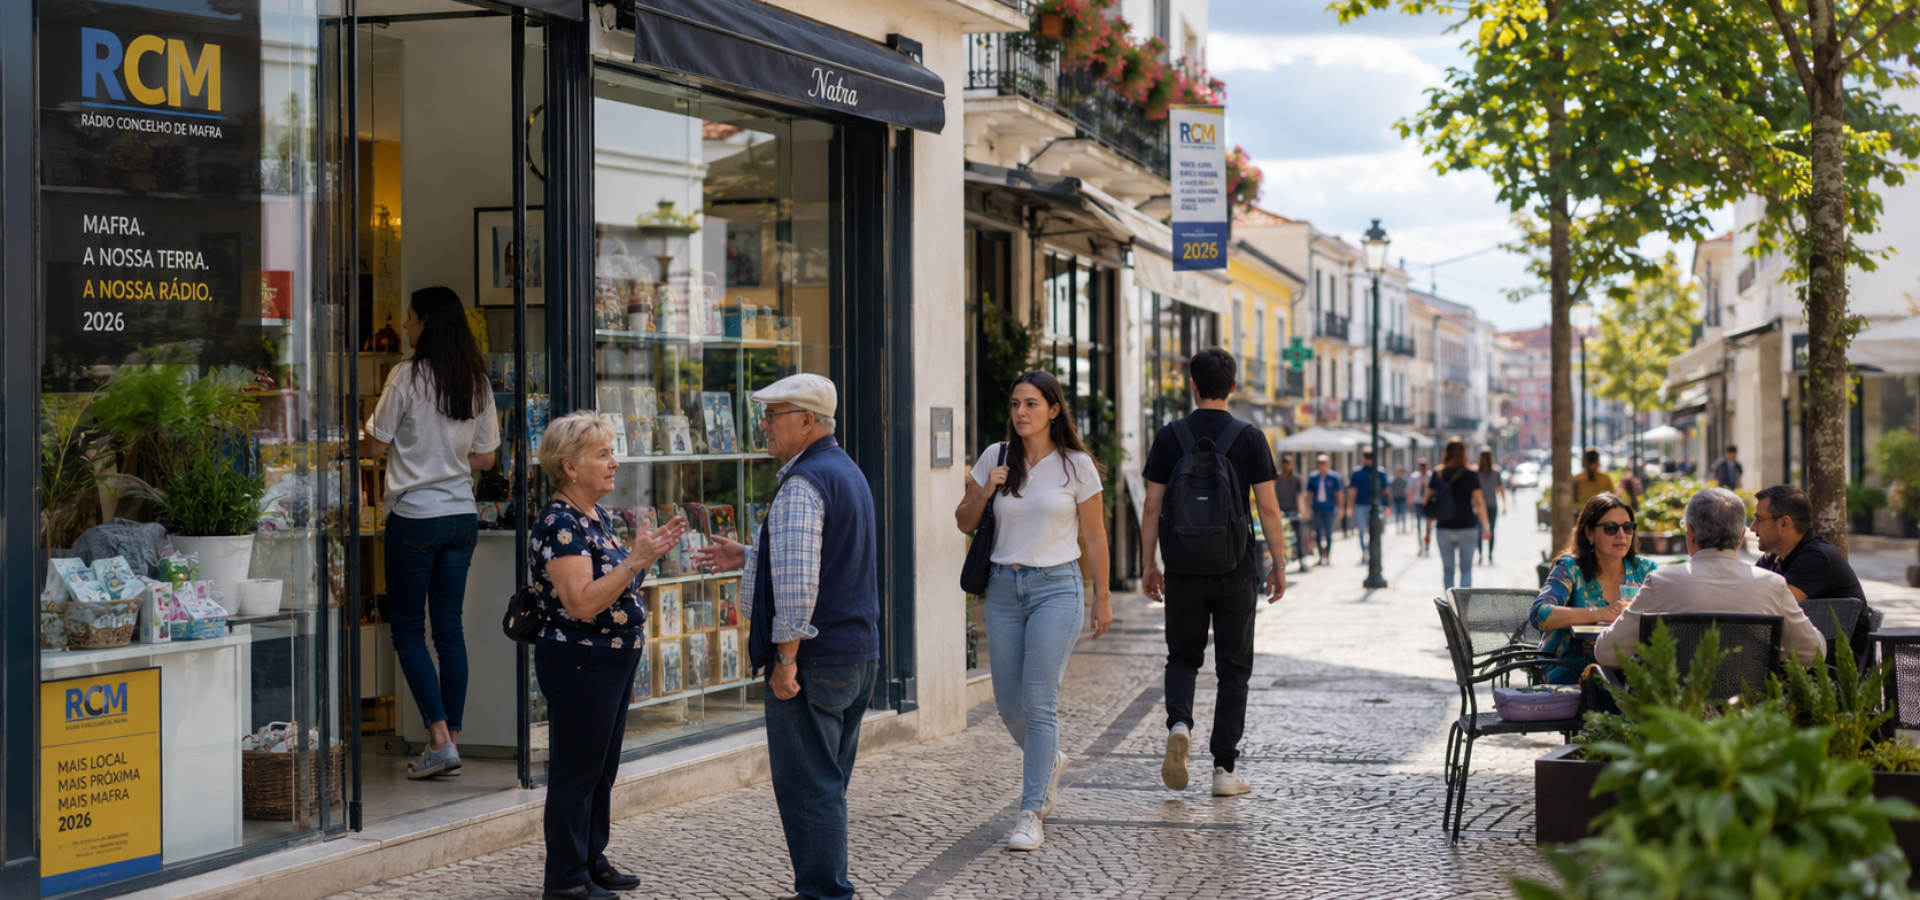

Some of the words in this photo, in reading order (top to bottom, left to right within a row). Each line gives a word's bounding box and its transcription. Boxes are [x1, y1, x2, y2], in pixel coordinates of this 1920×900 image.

[81, 27, 221, 111] RCM
[808, 67, 858, 106] Natra
[81, 112, 115, 129] RÁDIO
[117, 117, 172, 134] CONCELHO
[174, 122, 187, 135] DE
[189, 124, 222, 138] MAFRA
[1180, 122, 1215, 144] RCM
[83, 214, 145, 236] MAFRA.
[83, 247, 95, 266] A
[100, 248, 154, 268] NOSSA
[158, 250, 209, 270] TERRA.
[1183, 242, 1218, 260] 2026
[83, 281, 95, 299] A
[100, 281, 154, 300] NOSSA
[160, 276, 213, 301] RÁDIO.
[83, 311, 125, 332] 2026
[65, 682, 128, 720] RCM
[58, 757, 87, 774] MAIS
[90, 752, 128, 770] LOCAL
[58, 775, 87, 792] MAIS
[90, 769, 141, 787] PRÓXIMA
[58, 793, 87, 811] MAIS
[90, 788, 130, 805] MAFRA
[58, 812, 92, 832] 2026
